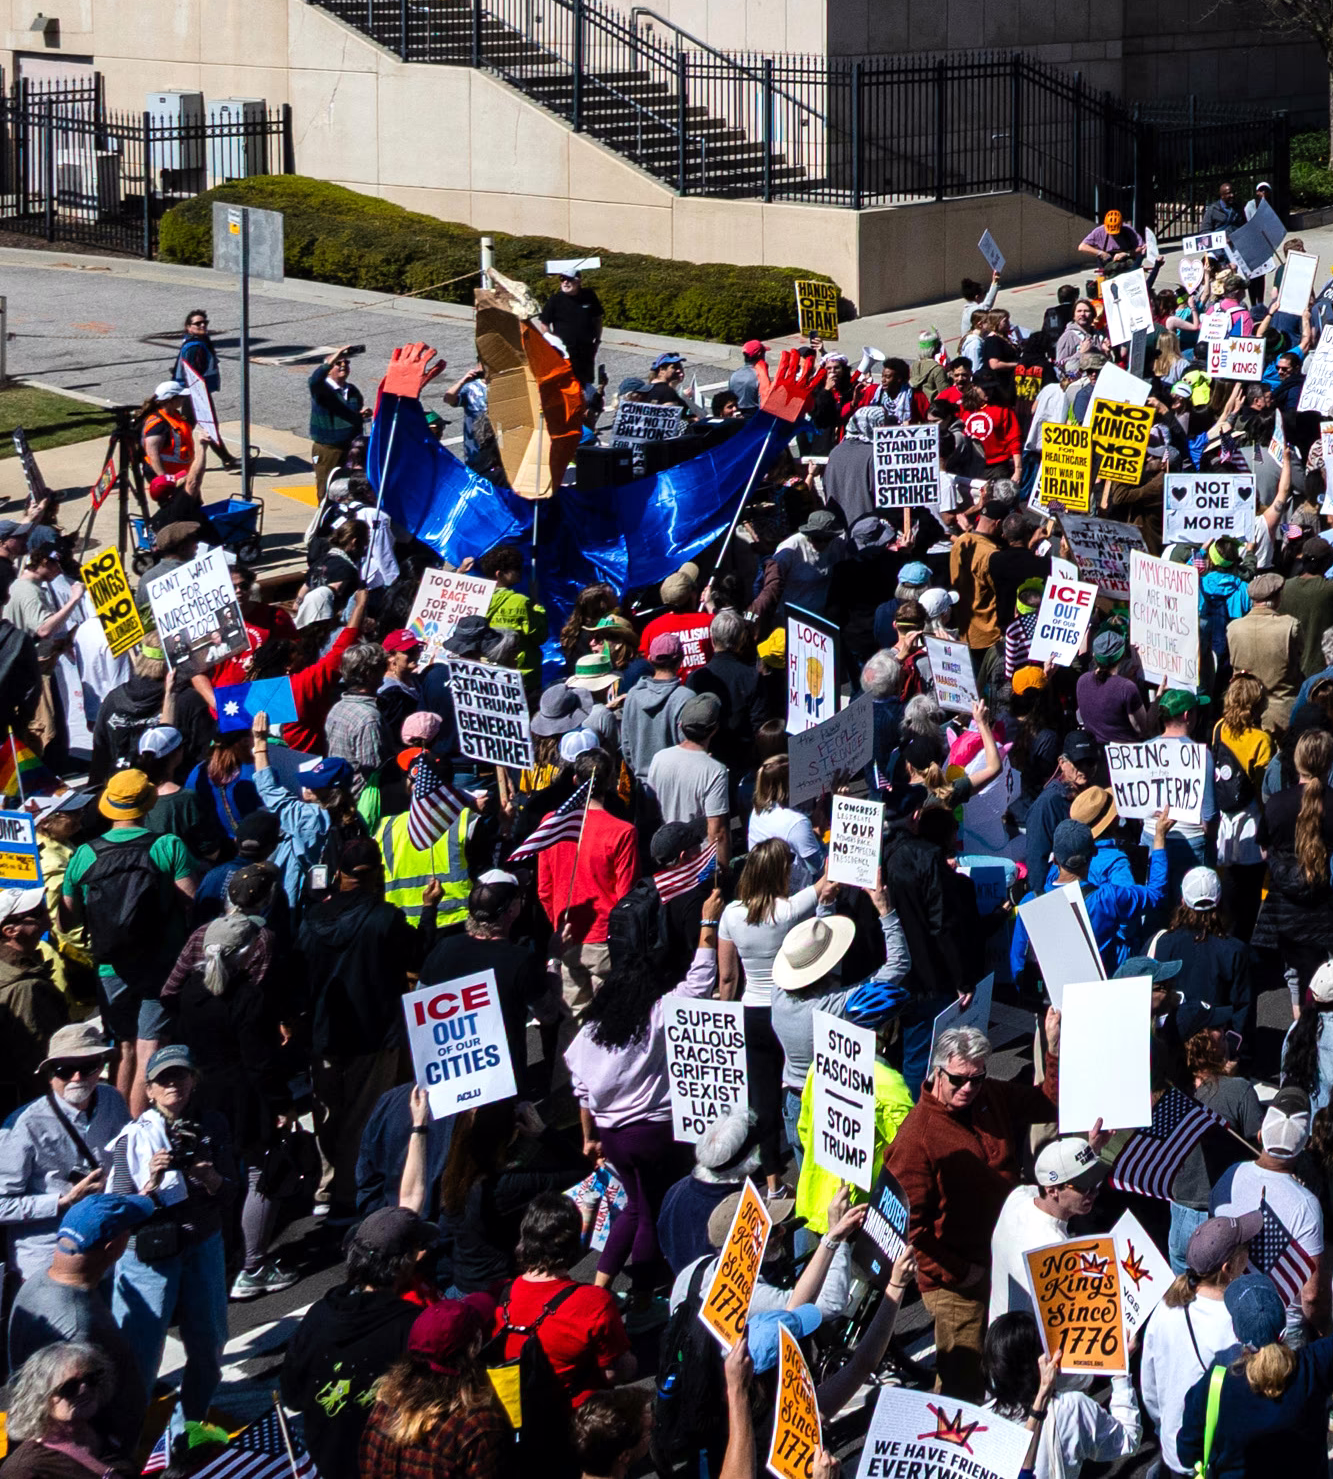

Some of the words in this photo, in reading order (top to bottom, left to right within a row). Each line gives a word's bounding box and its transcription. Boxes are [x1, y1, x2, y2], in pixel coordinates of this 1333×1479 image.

[800, 282, 836, 300] HANDS
[800, 298, 836, 311] OFF
[801, 311, 838, 330] IRAN!
[877, 428, 913, 439] MAY
[922, 427, 934, 437] 1:
[877, 440, 914, 453] STAND
[918, 439, 934, 451] UP
[877, 453, 891, 465] TO
[894, 452, 936, 465] TRUMP
[877, 468, 938, 486] GENERAL
[1195, 481, 1229, 495] NOT
[878, 485, 939, 504] STRIKE!
[1195, 495, 1229, 508] ONE
[1184, 516, 1234, 529] MORE
[84, 553, 116, 582] NO
[184, 556, 215, 585] WAIT
[89, 570, 126, 604] KINGS
[181, 582, 203, 599] FOR
[100, 598, 133, 627] NO
[159, 584, 231, 634] NUREMBERG
[188, 614, 217, 637] 2029
[1109, 745, 1170, 771] BRING
[1180, 744, 1201, 768] ON
[1114, 777, 1202, 811] MIDTERMS
[413, 982, 491, 1026] ICE
[432, 1013, 478, 1045] OUT
[676, 1009, 736, 1029] SUPER
[437, 1043, 453, 1056] OF
[456, 1037, 480, 1052] OUR
[668, 1027, 744, 1048] CALLOUS
[828, 1029, 861, 1061] STOP
[425, 1044, 500, 1085] CITIES
[674, 1045, 737, 1066] RACIST
[671, 1063, 744, 1085] GRIFTER
[816, 1053, 874, 1096] FASCISM
[677, 1082, 740, 1103] SEXIST
[827, 1107, 862, 1139] STOP
[822, 1131, 867, 1168] TRUMP
[1041, 1253, 1079, 1282] No
[1041, 1271, 1116, 1308] Kings
[1047, 1299, 1117, 1328] Since
[1059, 1326, 1119, 1355] 1776
